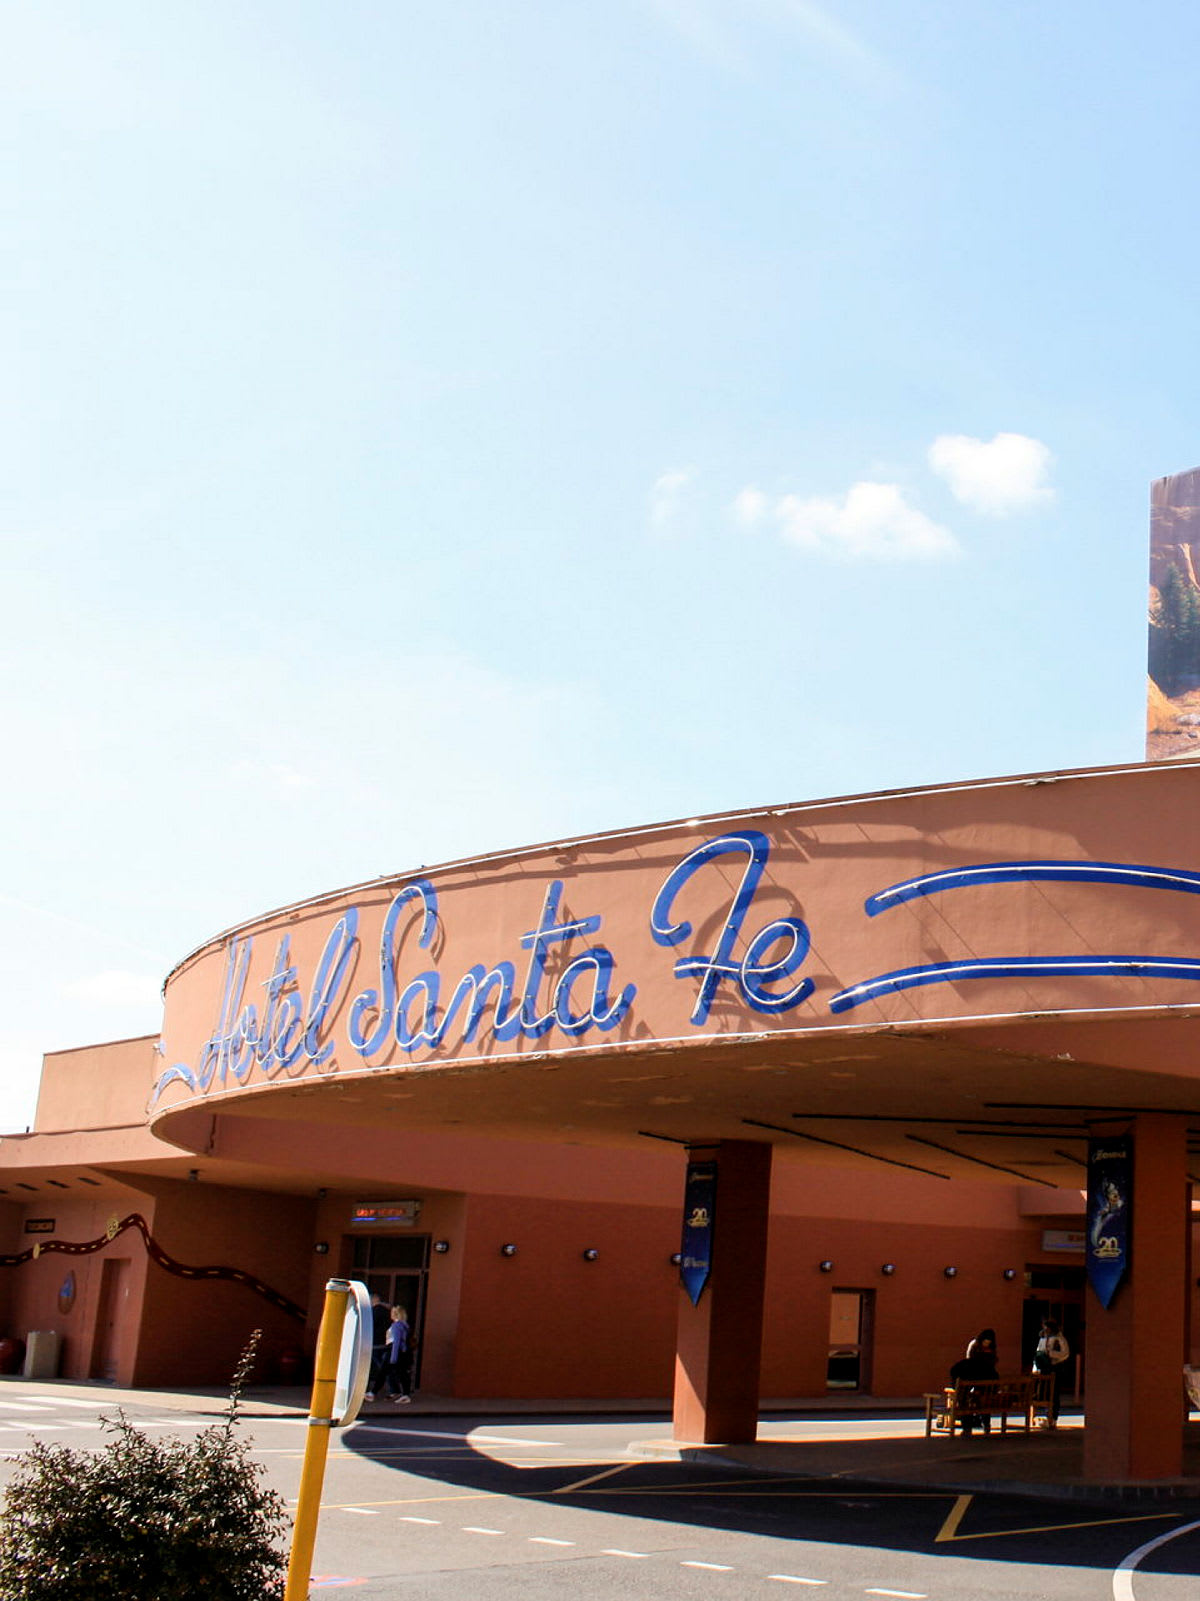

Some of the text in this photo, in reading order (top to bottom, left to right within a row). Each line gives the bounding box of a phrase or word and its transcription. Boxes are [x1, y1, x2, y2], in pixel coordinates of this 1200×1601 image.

[198, 830, 816, 1086] Hotel Santa Fe
[1098, 1235, 1118, 1249] 20
